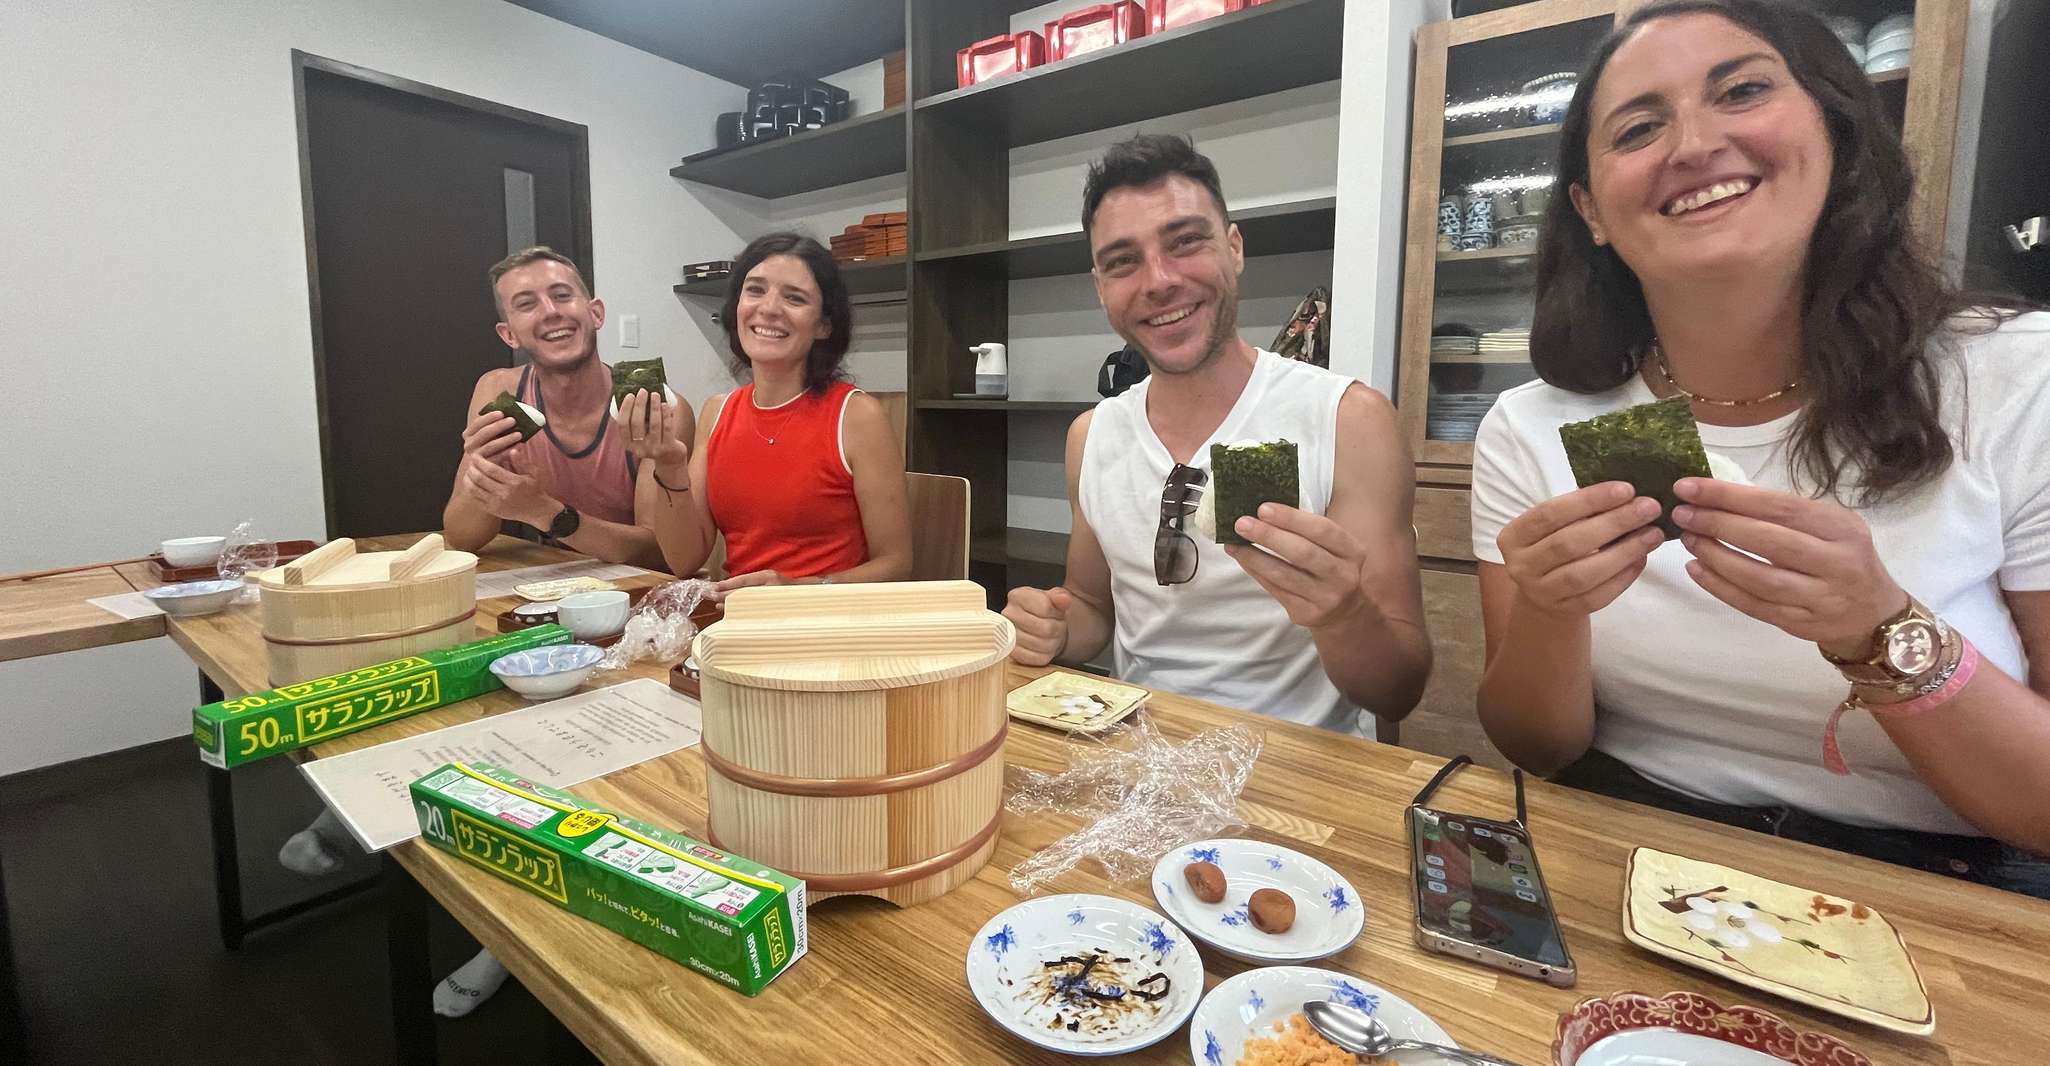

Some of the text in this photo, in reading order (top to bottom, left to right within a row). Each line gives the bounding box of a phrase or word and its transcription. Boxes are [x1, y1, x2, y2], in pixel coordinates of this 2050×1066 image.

[223, 658, 415, 714] 50m サランラップ
[240, 717, 294, 755] 50m
[306, 678, 431, 732] サランラップ
[420, 801, 456, 847] 20m
[458, 822, 555, 886] サランラップ
[688, 911, 732, 937] AsahiKASEI
[746, 932, 761, 979] AsahiKASEI
